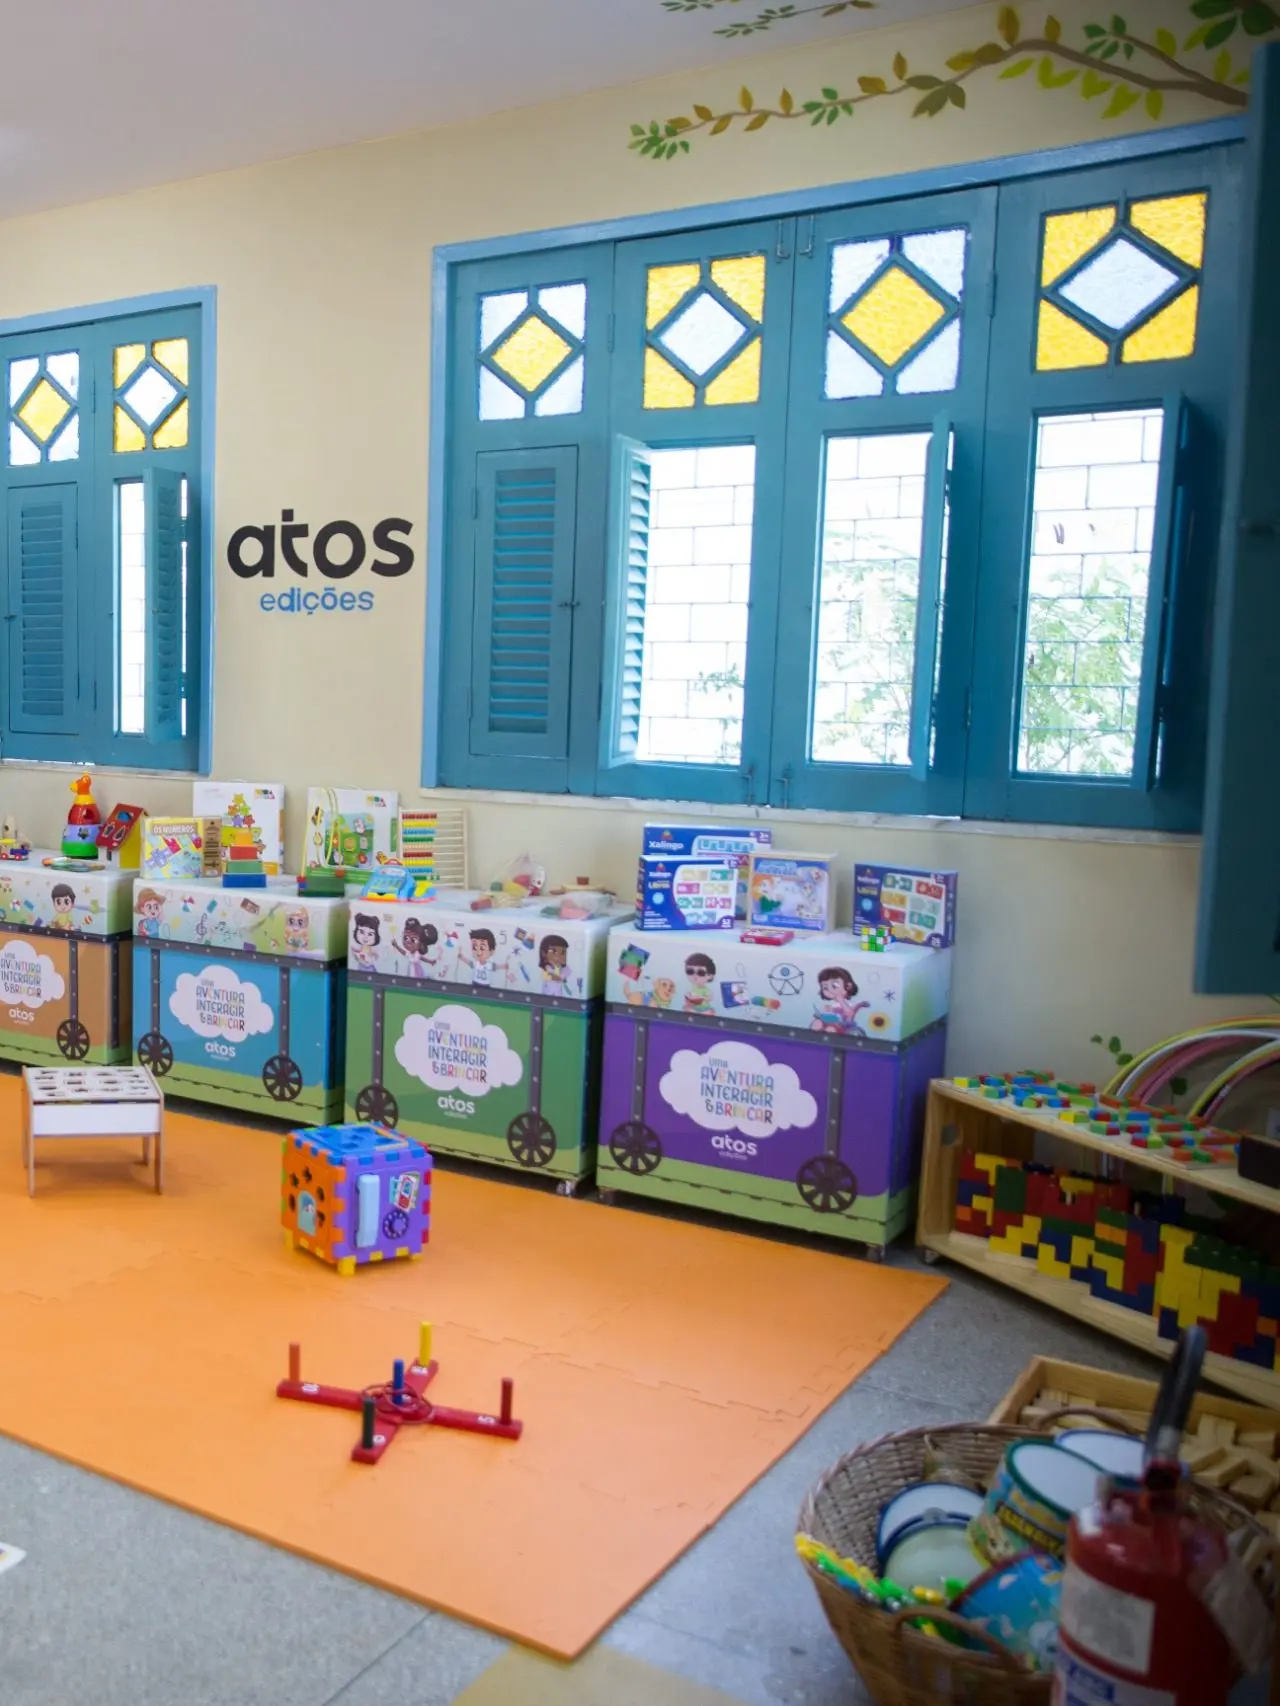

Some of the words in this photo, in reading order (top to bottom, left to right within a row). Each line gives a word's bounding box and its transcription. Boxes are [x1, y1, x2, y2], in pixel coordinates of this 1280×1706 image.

[227, 509, 415, 579] atos
[260, 587, 375, 615] edições
[9, 1008, 35, 1022] atos
[205, 1041, 236, 1057] atos
[428, 1029, 488, 1052] AVENTURA
[429, 1045, 487, 1068] INTERAGIR
[701, 1066, 774, 1091] AVENTURA
[438, 1095, 475, 1114] atos
[701, 1083, 773, 1108] INTERAGIR
[711, 1135, 758, 1156] atos
